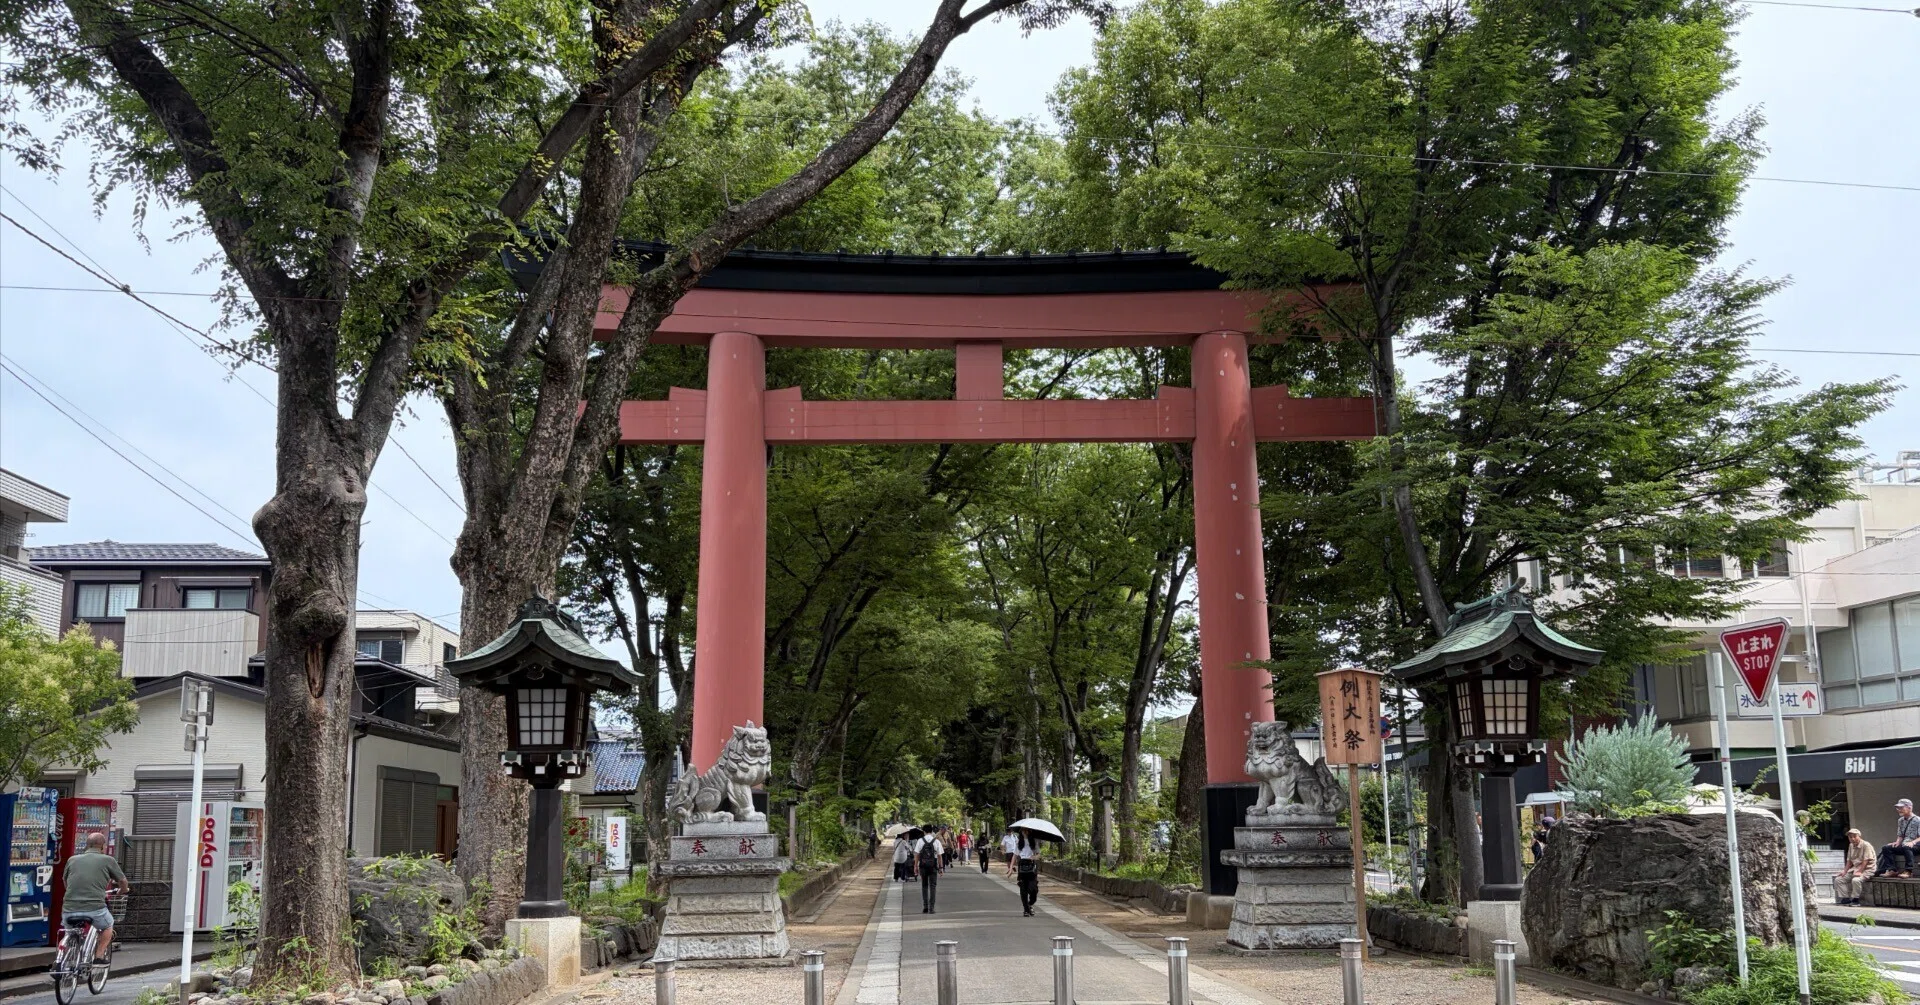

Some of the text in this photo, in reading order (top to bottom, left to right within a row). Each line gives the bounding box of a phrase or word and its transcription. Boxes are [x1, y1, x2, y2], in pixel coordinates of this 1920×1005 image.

[1736, 633, 1774, 655] 止まれ
[1743, 654, 1770, 671] STOP
[1740, 692, 1800, 708] 氷社
[1340, 676, 1365, 751] 例大祭
[1844, 755, 1876, 774] Bibli
[200, 817, 218, 869] DyDo
[612, 823, 620, 848] DyDo
